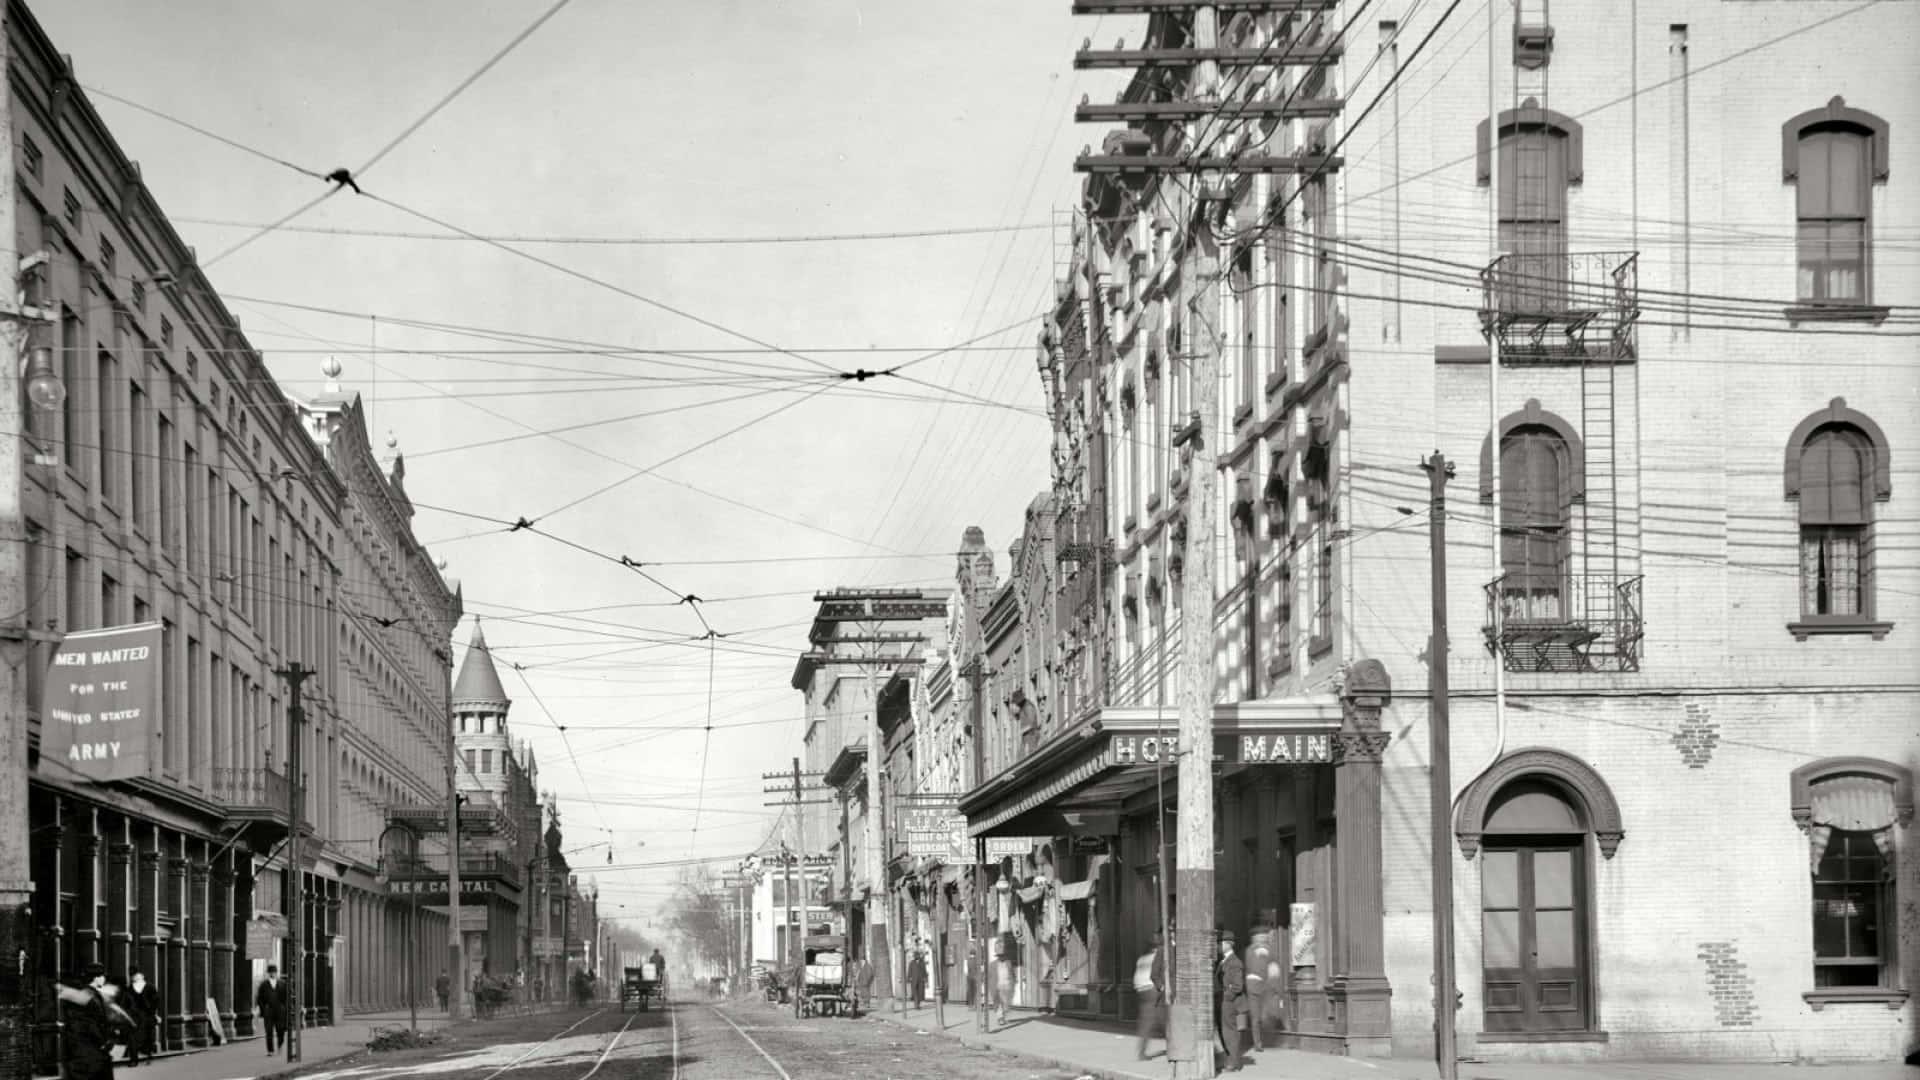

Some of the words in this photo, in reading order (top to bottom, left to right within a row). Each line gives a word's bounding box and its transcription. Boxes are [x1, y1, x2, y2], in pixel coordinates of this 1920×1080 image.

[55, 652, 86, 666] MEN
[92, 646, 149, 665] WANTED
[70, 683, 95, 695] FOR
[103, 681, 128, 692] THE
[52, 708, 92, 725] UNITED
[100, 708, 141, 722] STATES
[69, 741, 121, 760] ARMY
[1115, 736, 1225, 762] HOT
[1243, 735, 1328, 761] MAIN
[390, 880, 423, 893] NEW
[429, 880, 492, 893] CAITAL
